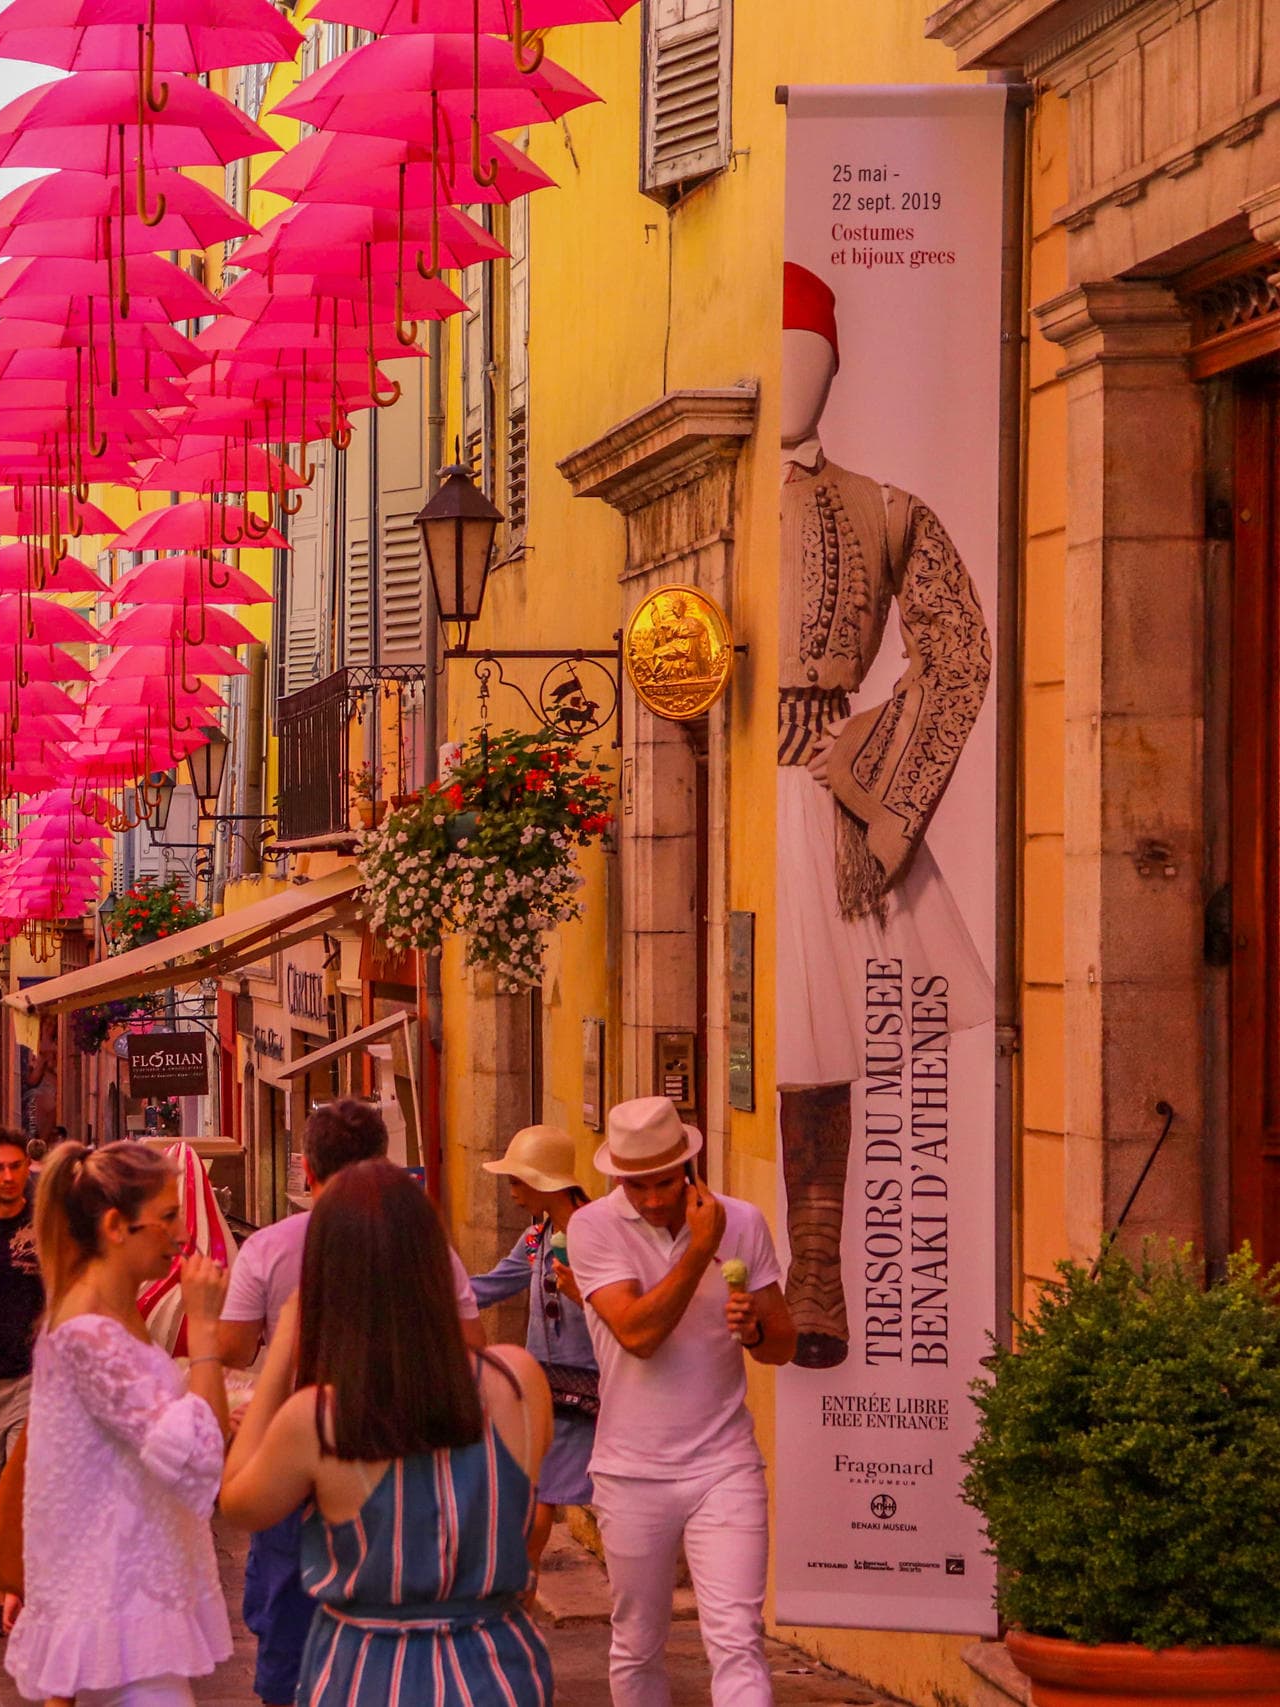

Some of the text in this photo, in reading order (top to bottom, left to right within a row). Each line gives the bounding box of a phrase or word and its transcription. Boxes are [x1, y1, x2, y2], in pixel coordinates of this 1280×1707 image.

[832, 164, 852, 182] 25
[858, 164, 887, 182] mai
[832, 192, 942, 214] 22 sept. 2019
[831, 223, 915, 241] Costumes
[831, 247, 955, 269] et bijoux grecs
[132, 1050, 203, 1067] FLORIAN
[865, 957, 903, 1366] TRESORS DU MUSEE
[911, 1211, 949, 1368] BENAKI
[822, 1393, 949, 1415] ENTRÉE LIBRE
[822, 1413, 949, 1430] FREE ENTRANCE
[834, 1454, 933, 1478] Fragonard
[849, 1478, 916, 1486] PARFUMEUR
[851, 1521, 918, 1532] BENAKI MUSEUM
